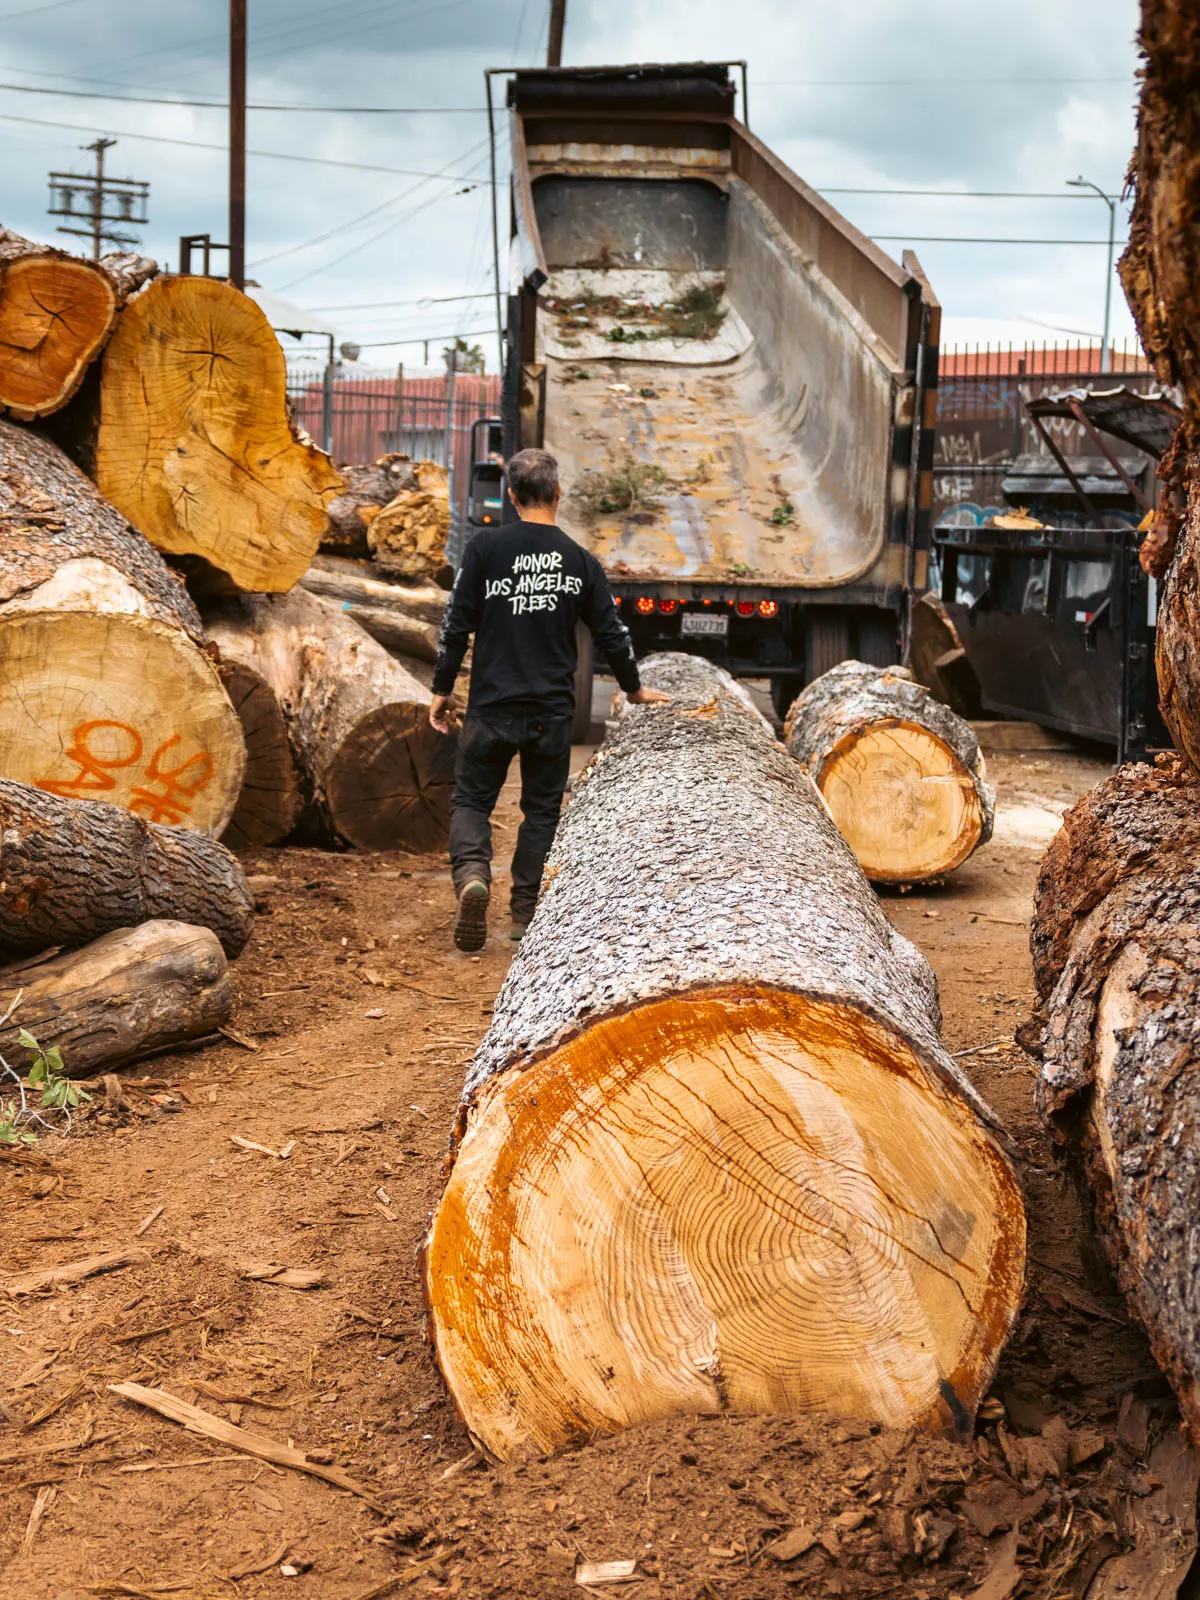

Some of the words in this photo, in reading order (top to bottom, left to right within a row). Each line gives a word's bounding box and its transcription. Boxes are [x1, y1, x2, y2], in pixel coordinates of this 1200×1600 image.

[512, 551, 562, 574] HONOR
[485, 578, 513, 599] LOS
[515, 572, 583, 595] ANGELES
[508, 594, 558, 615] TREES
